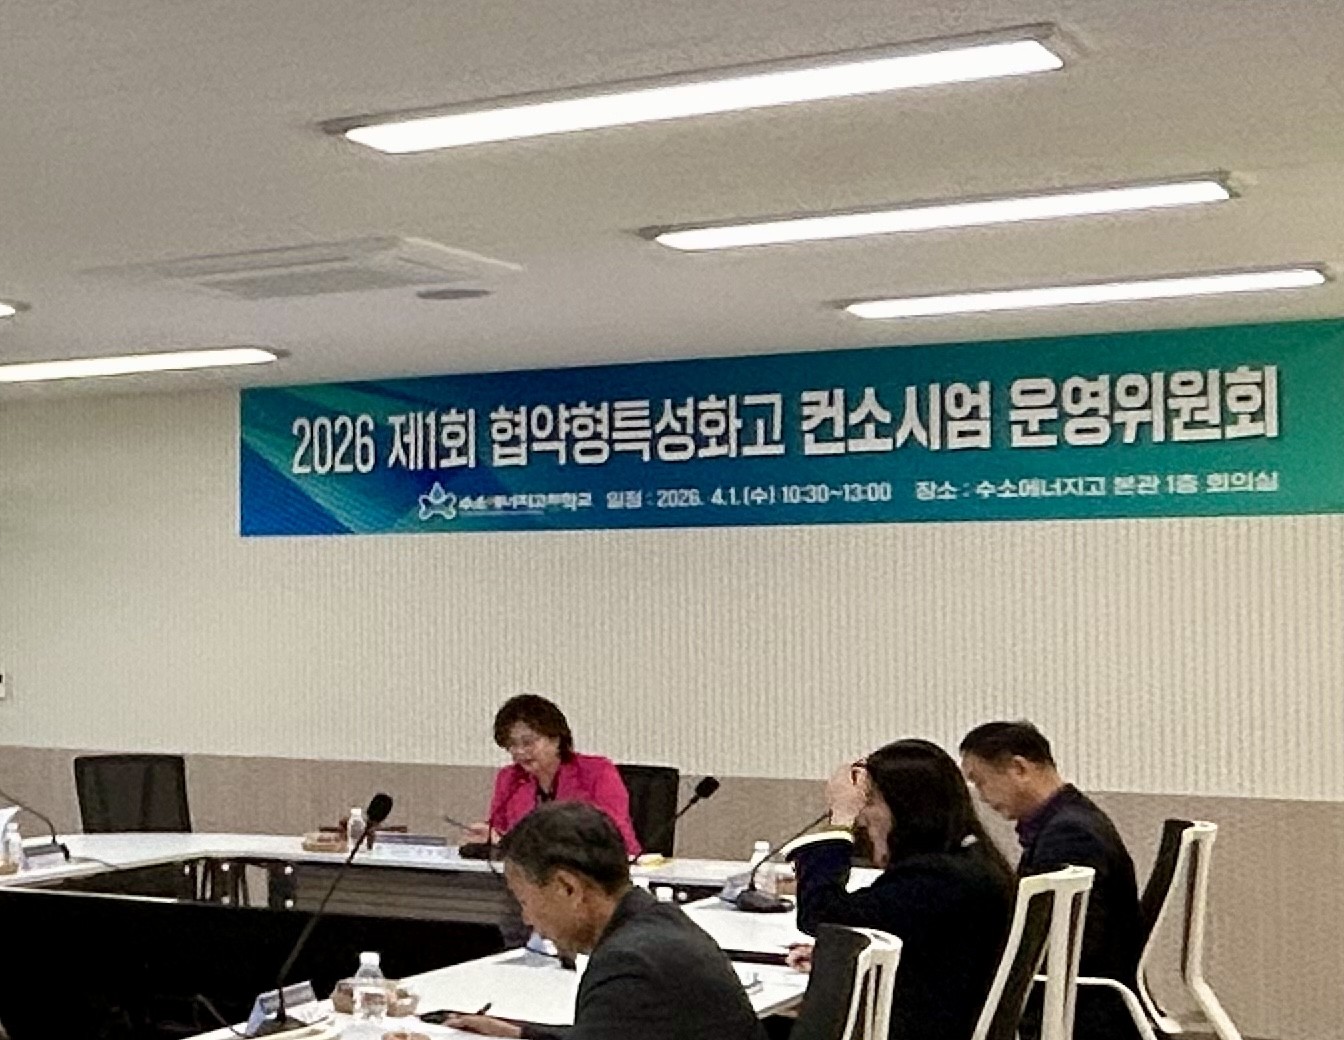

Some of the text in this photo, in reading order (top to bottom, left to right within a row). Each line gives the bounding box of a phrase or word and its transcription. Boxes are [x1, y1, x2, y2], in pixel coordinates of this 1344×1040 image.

[291, 364, 1280, 475] 2026 제1회 협약형특성화고 컨소시엄 운영위원회
[657, 488, 704, 507] 2026.
[711, 485, 775, 506] 4.1.(수)
[781, 481, 891, 504] 10:30~13:00
[916, 480, 958, 500] 장소
[976, 475, 1106, 499] 수소에너지고
[1206, 470, 1280, 492] 회의실
